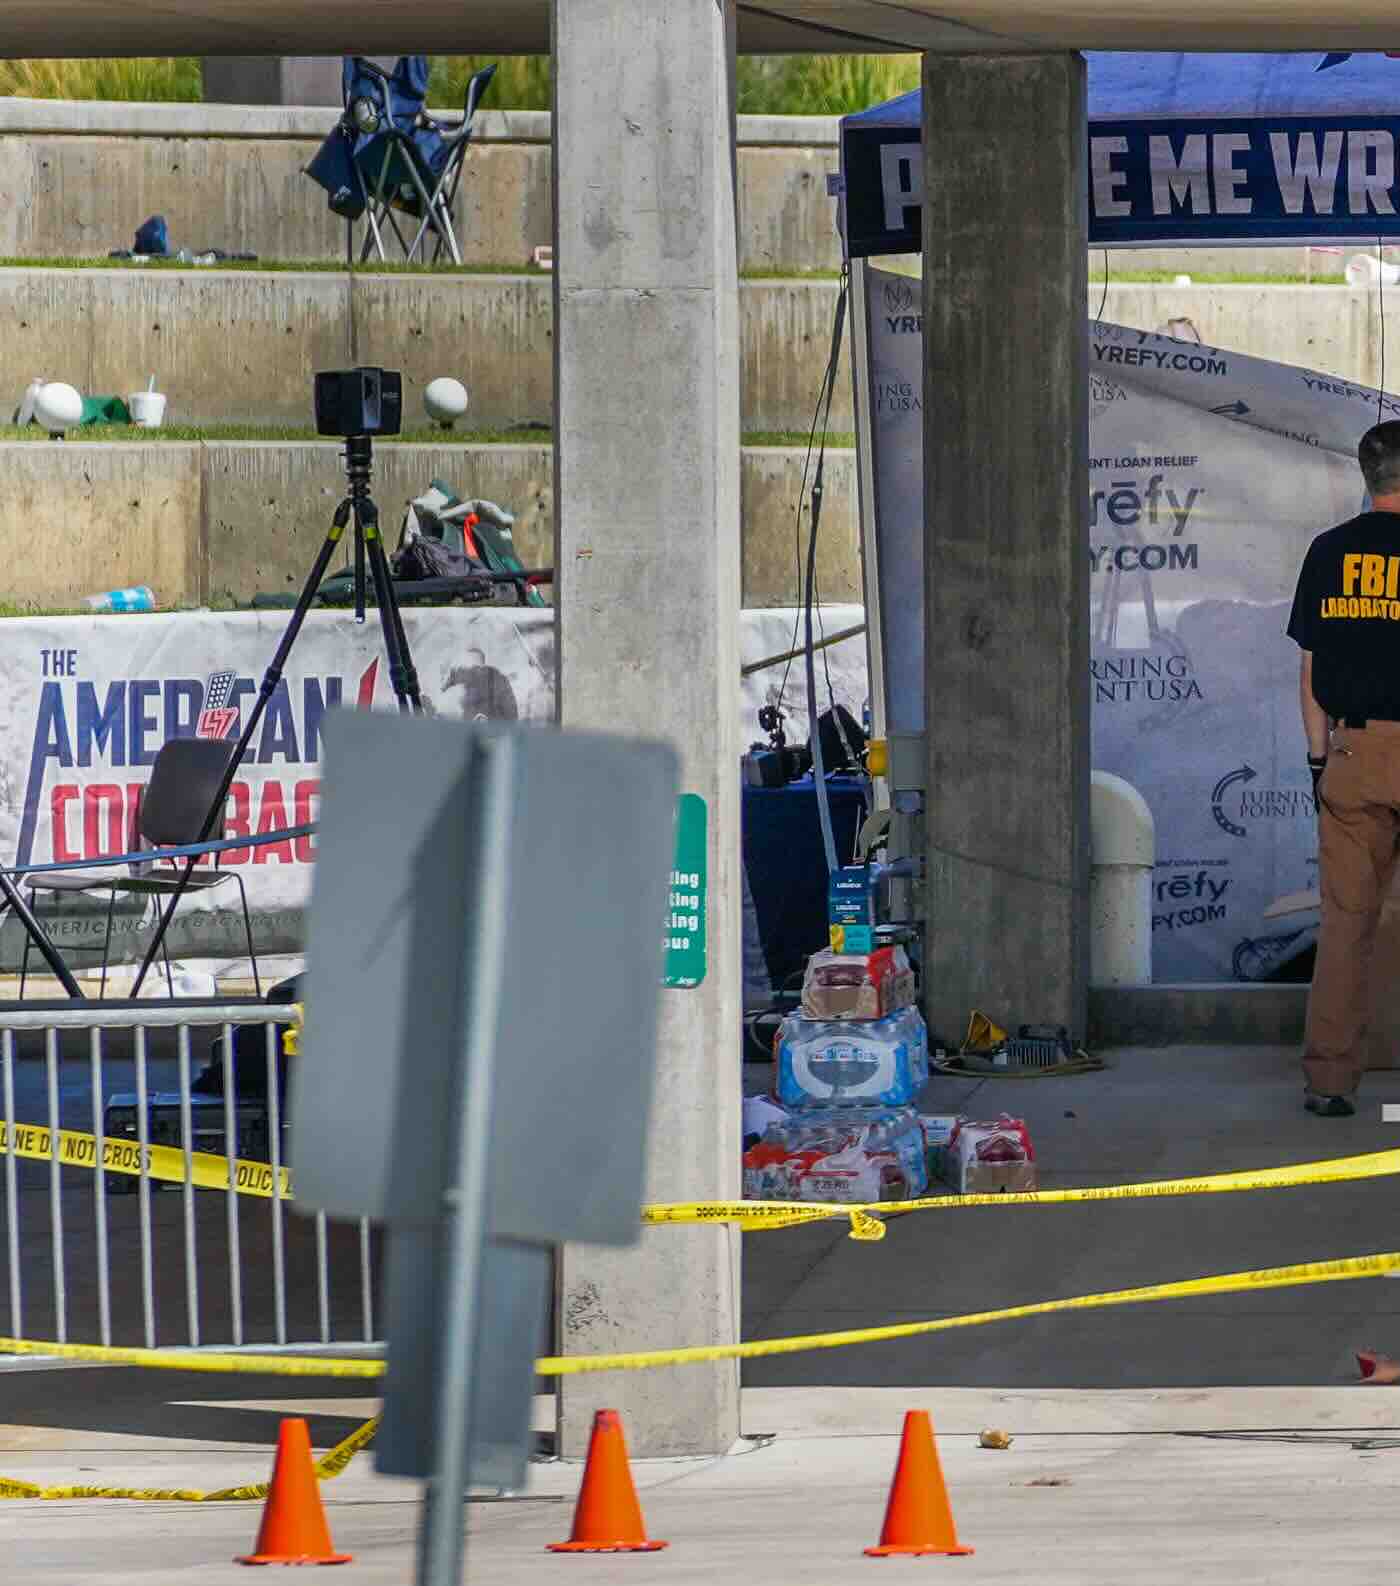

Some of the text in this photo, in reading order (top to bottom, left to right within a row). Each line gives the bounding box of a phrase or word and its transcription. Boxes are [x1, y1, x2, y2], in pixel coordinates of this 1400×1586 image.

[1149, 132, 1253, 215] ME
[1092, 343, 1229, 377] YREFY.COM
[1114, 457, 1151, 469] LOAN
[1153, 455, 1199, 468] RELIEF
[1343, 553, 1400, 599] FBI
[41, 650, 77, 676] THE
[1147, 679, 1204, 701] USA
[1240, 802, 1299, 818] POINT
[1242, 790, 1315, 804] TURNIN
[1153, 871, 1231, 902] rēfy
[0, 1127, 34, 1151] LNE
[39, 1133, 60, 1154] D
[66, 1137, 97, 1161] NOT
